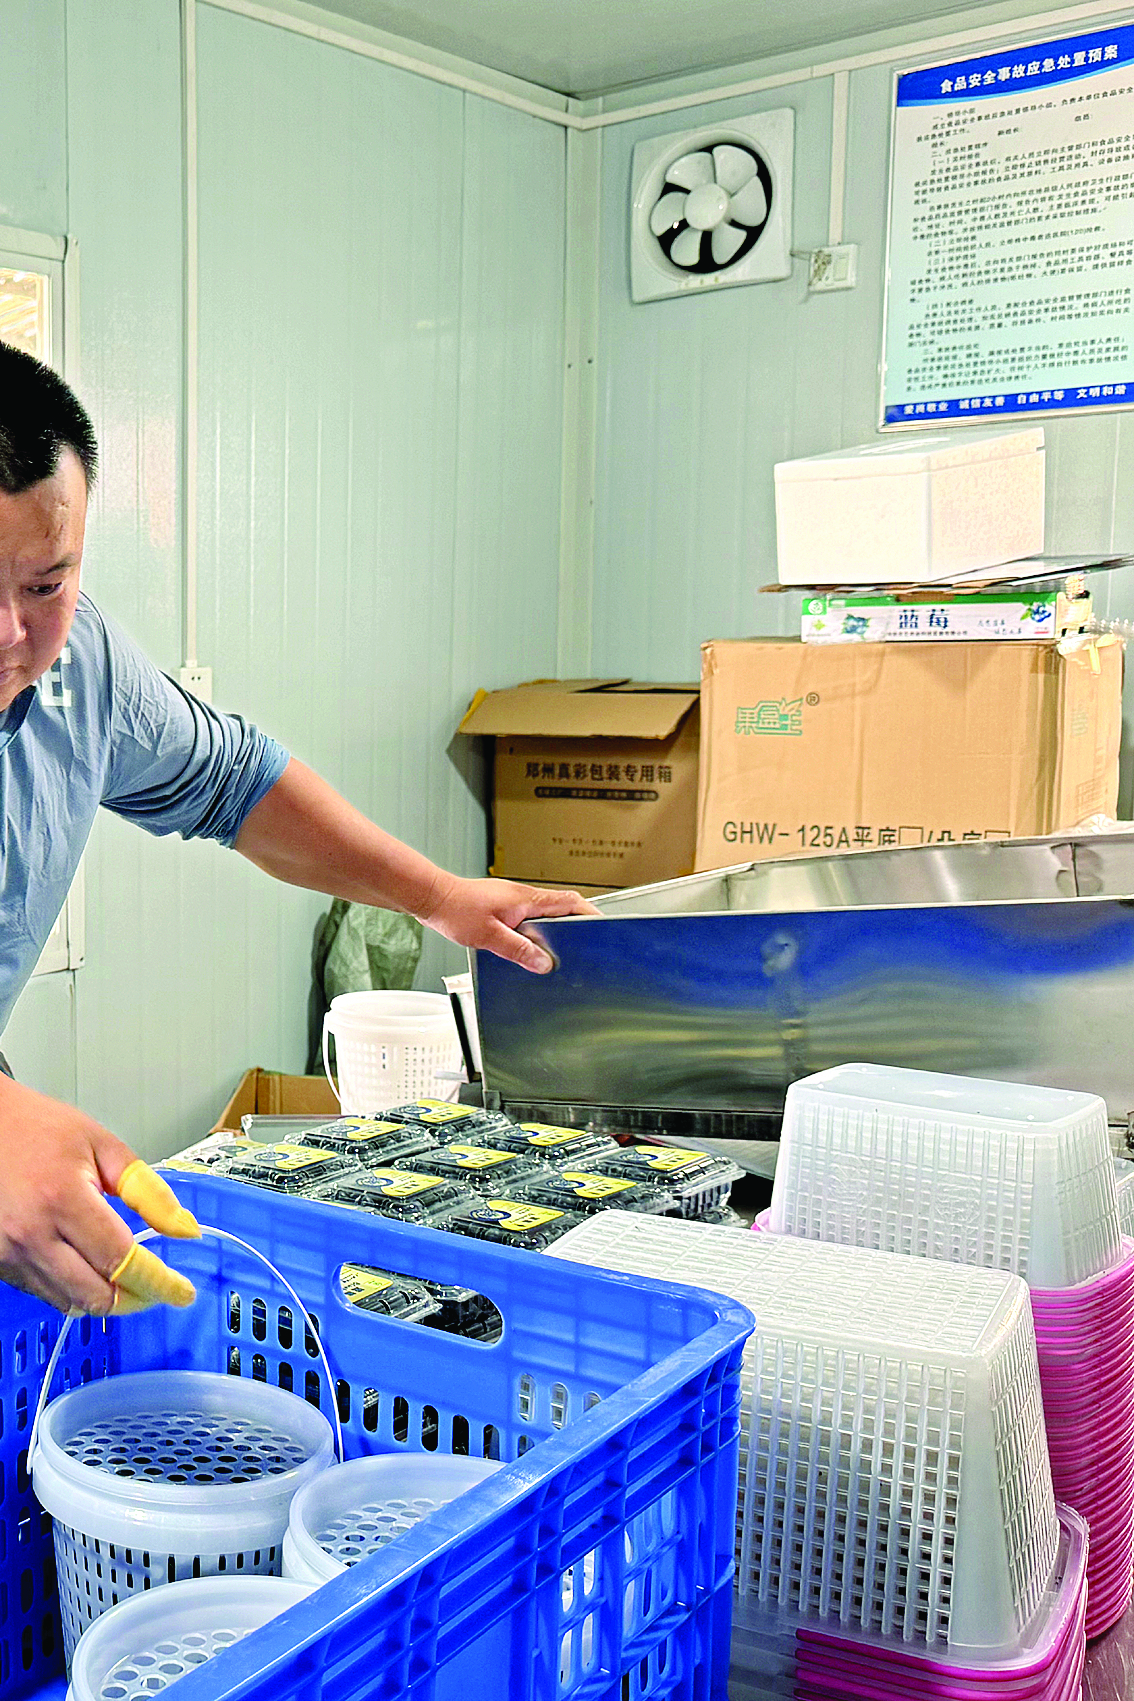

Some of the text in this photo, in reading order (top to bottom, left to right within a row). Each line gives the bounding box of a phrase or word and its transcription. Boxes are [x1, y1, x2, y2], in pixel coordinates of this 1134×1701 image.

[940, 44, 1120, 95] 食品安全事故应急处置预案
[1016, 390, 1065, 405] 自由平等
[1076, 383, 1127, 400] 文明和谐
[898, 608, 950, 630] 蓝莓
[525, 762, 673, 783] 郑州真彩包装专用箱
